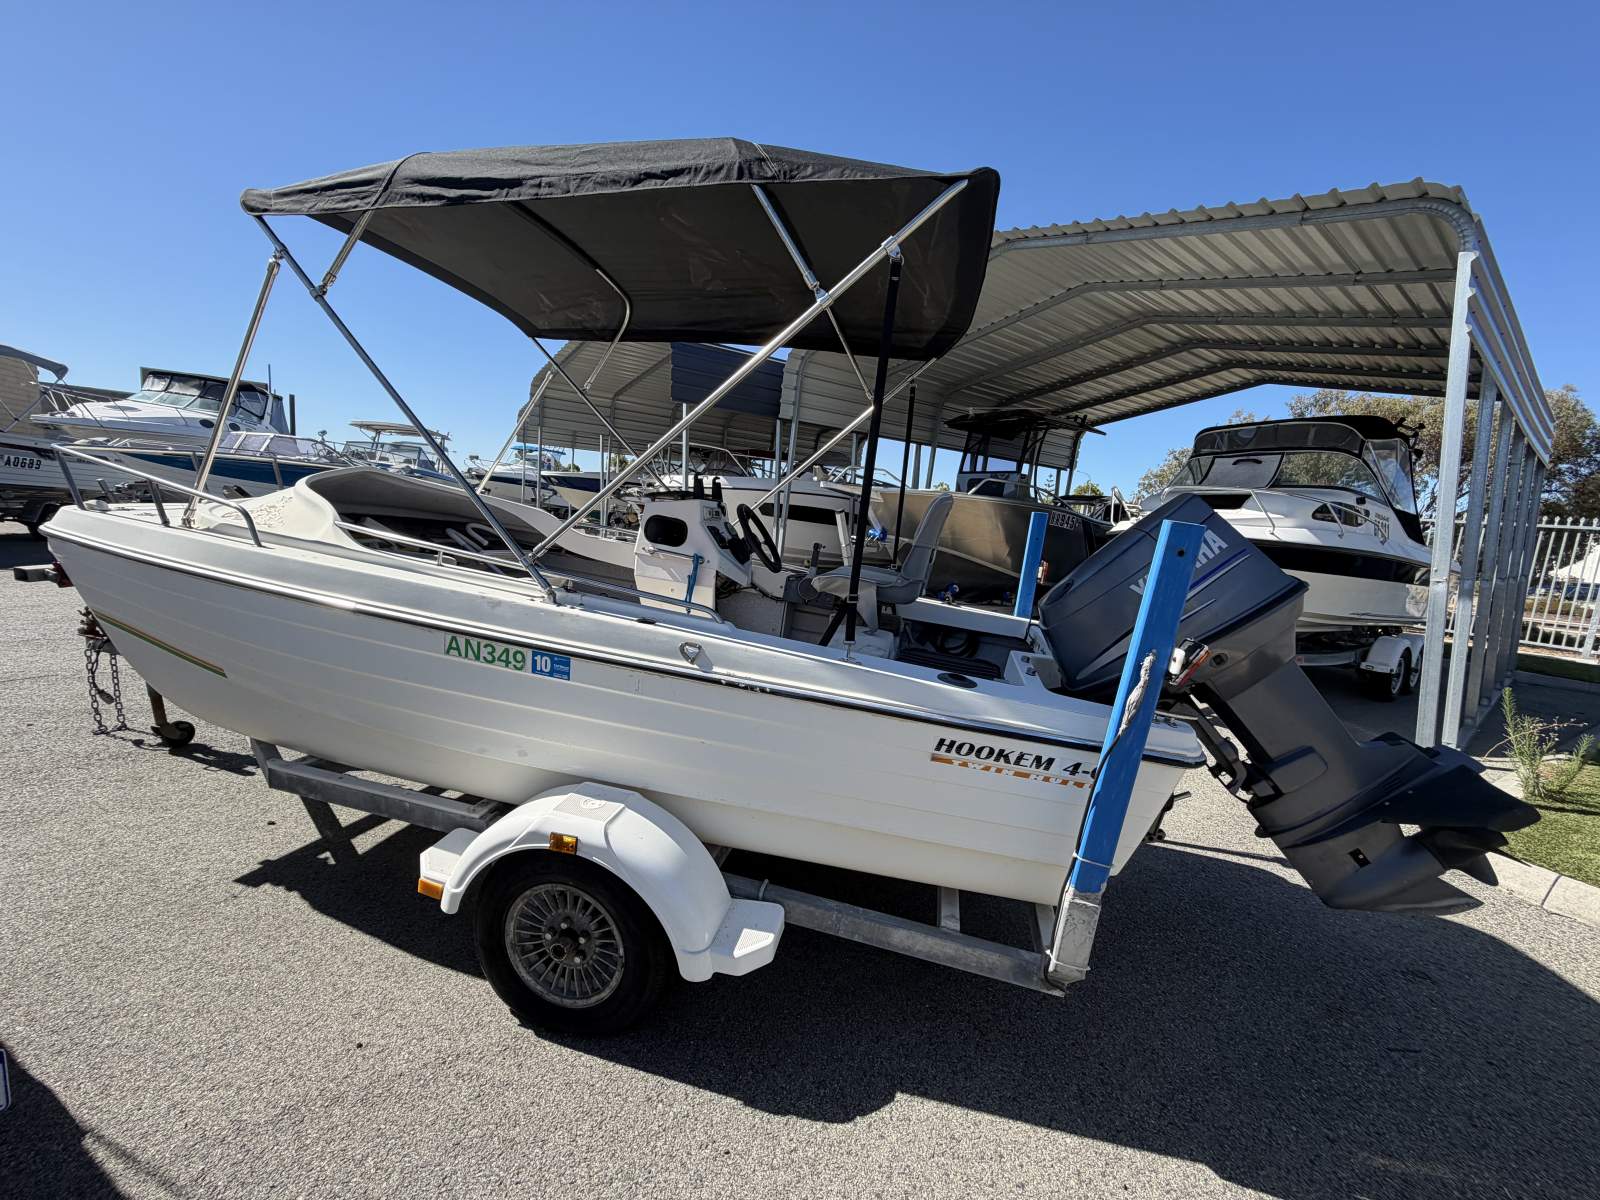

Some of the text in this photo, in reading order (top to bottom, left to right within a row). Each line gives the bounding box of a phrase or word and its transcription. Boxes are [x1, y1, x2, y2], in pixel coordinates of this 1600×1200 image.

[446, 636, 526, 671] AN349
[534, 654, 551, 673] 10
[934, 738, 1056, 772] HOOKEM
